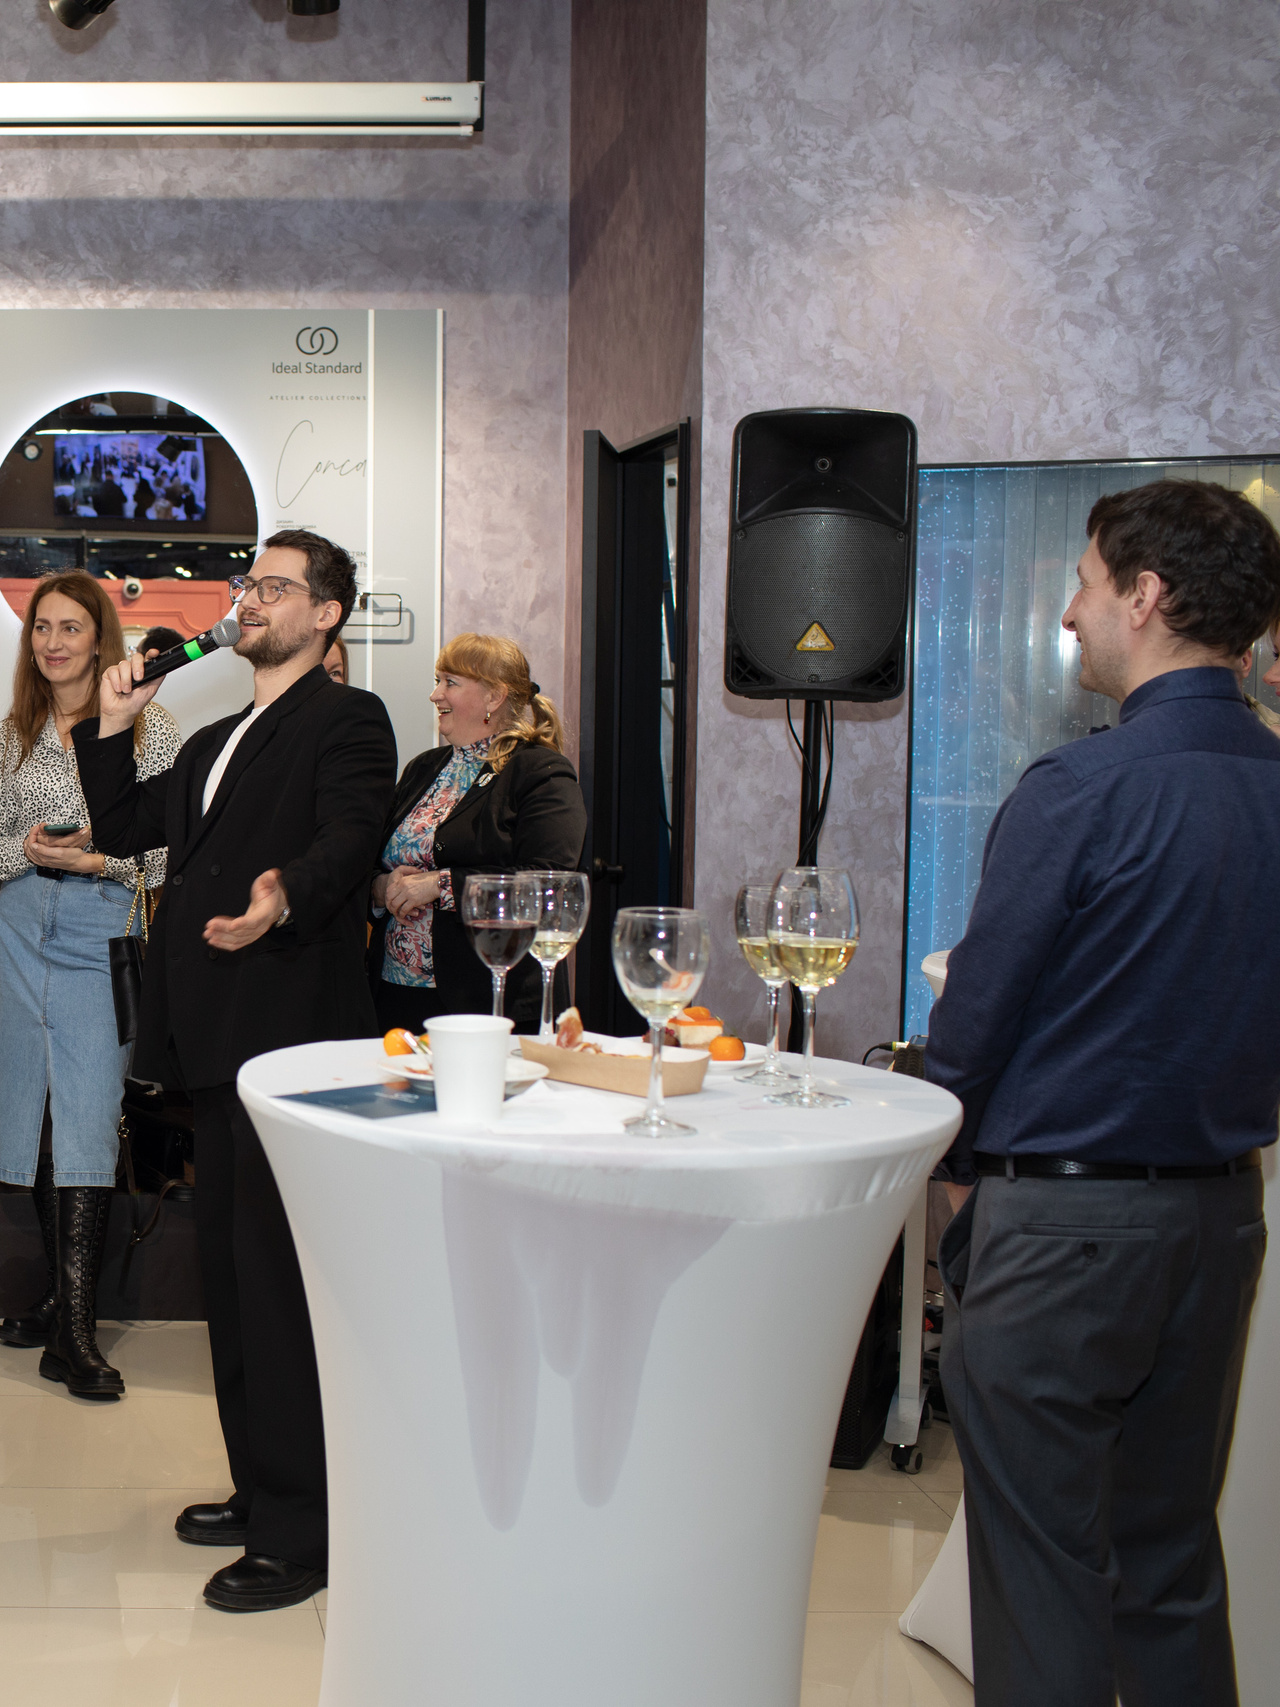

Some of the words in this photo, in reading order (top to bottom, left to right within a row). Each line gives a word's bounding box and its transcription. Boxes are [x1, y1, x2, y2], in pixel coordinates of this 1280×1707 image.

[272, 361, 302, 374] Ideal
[305, 361, 362, 374] Standard
[276, 419, 368, 509] Conca
